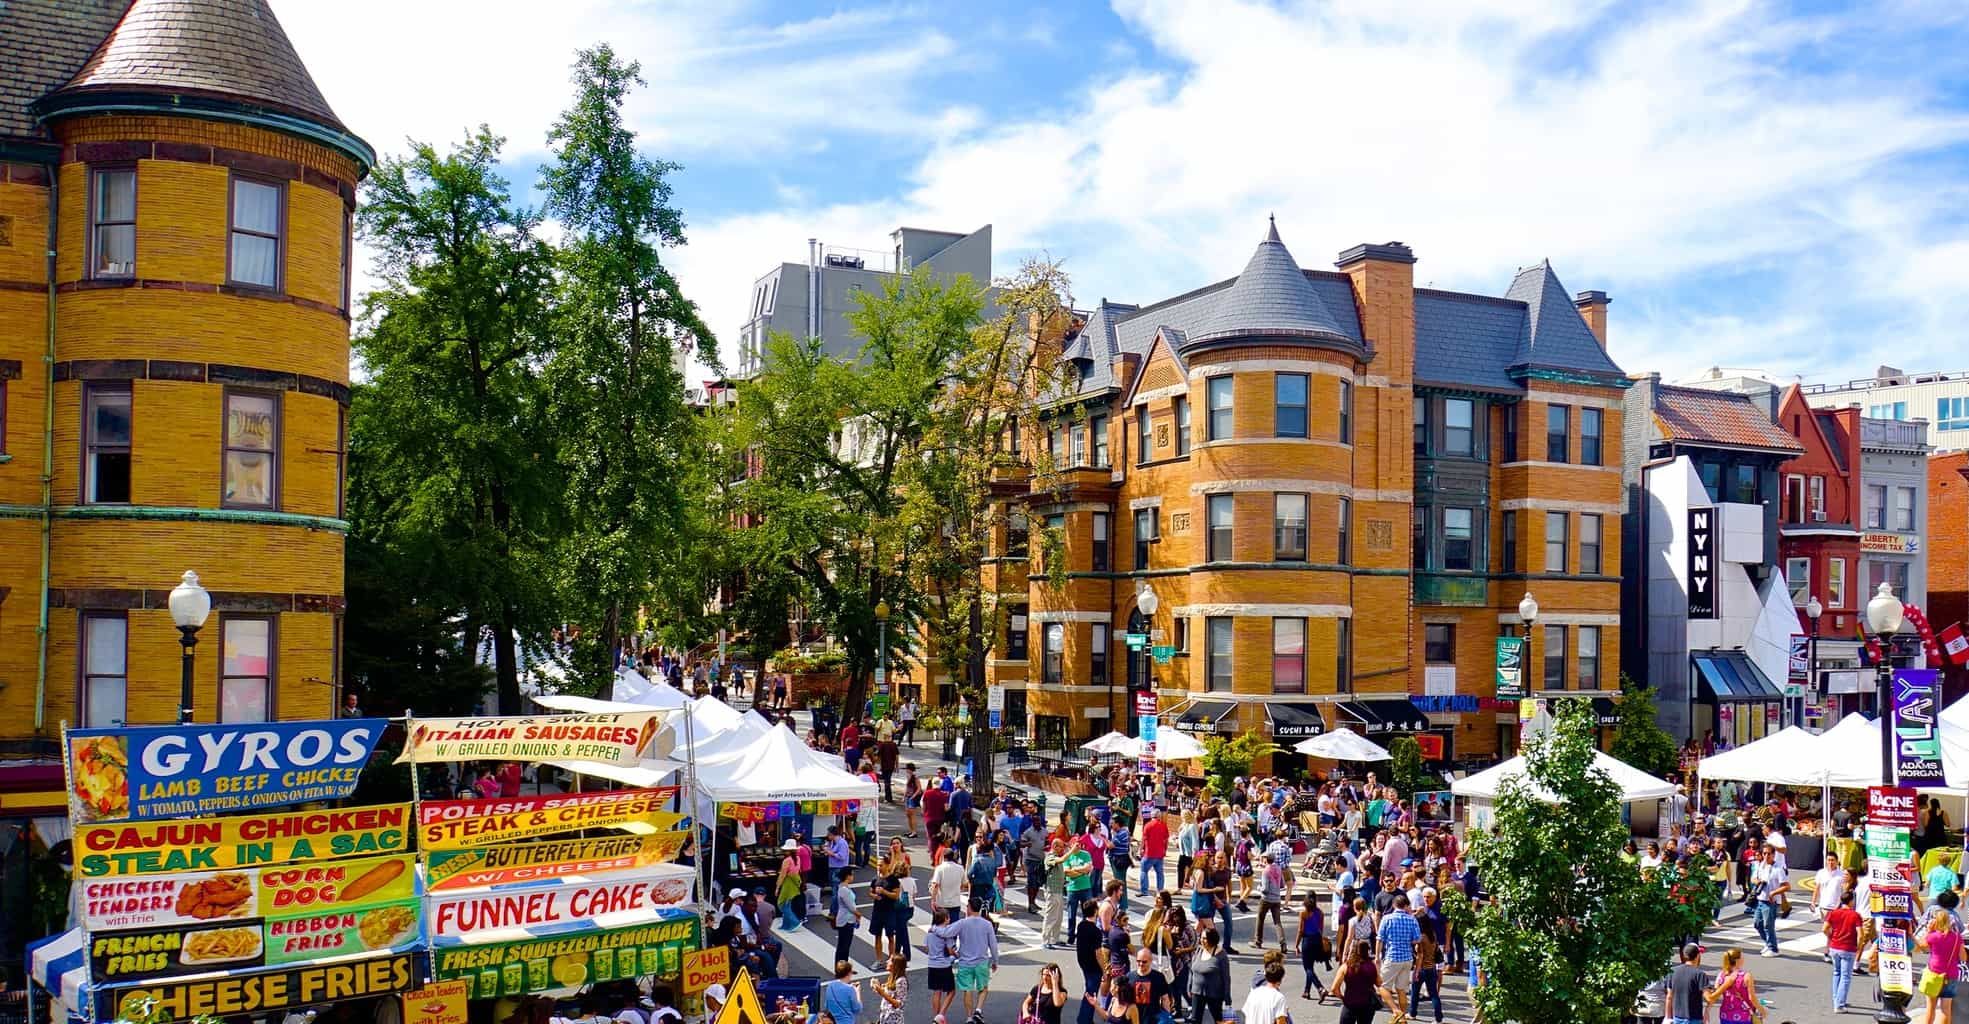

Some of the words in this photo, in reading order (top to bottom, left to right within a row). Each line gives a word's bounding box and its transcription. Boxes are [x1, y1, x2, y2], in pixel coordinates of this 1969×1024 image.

[1864, 534, 1899, 542] LIBERTY
[456, 719, 506, 729] HOT
[547, 714, 622, 724] SWEET
[1897, 678, 1936, 756] PLAY
[426, 727, 516, 742] ITALIAN
[523, 725, 639, 745] SAUSAGES
[1279, 726, 1302, 735] SUSHI
[1304, 726, 1320, 734] BAR
[142, 728, 370, 777] GYROS
[436, 743, 455, 757] W/
[458, 742, 507, 757] GRILLED
[512, 742, 557, 757] ONIONS
[562, 743, 570, 756] &
[576, 743, 621, 761] PEPPER
[1898, 769, 1943, 777] MORGAN
[1901, 761, 1938, 770] ADAMS
[138, 779, 201, 801] LAMB
[215, 773, 271, 794] BEEF
[137, 804, 151, 817] W/
[151, 800, 198, 815] TOMATO,
[199, 796, 241, 811] PEPPERS
[242, 795, 250, 806] &
[251, 791, 288, 805] ONIONS
[289, 790, 303, 801] ON
[304, 786, 324, 799] PITA
[423, 801, 535, 825] POLISH
[542, 790, 674, 810] SAUSAGE
[1870, 795, 1915, 808] RACINE
[85, 823, 222, 851] CAJUN
[239, 807, 403, 840] CHICKEN
[427, 814, 521, 843] STEAK
[530, 811, 547, 826] &
[559, 800, 665, 821] CHEESE
[475, 830, 522, 844] GRILLED
[525, 824, 573, 836] PEPPERS
[81, 846, 220, 877] STEAK
[236, 842, 274, 865] IN
[291, 838, 316, 859] A
[331, 829, 402, 855] SAC
[485, 839, 593, 868] BUTTERFLY
[593, 836, 642, 858] FRIES
[262, 866, 346, 888] CORN
[467, 871, 504, 884] W/
[514, 858, 632, 876] CHEESE
[87, 880, 176, 898] CHICKEN
[273, 884, 337, 908] DOG
[88, 895, 174, 917] TENDERS
[437, 892, 560, 935] FUNNEL
[569, 883, 649, 917] CAKE
[105, 916, 128, 926] with
[132, 913, 155, 923] Fries
[271, 913, 356, 936] RIBBON
[92, 932, 181, 958] FRENCH
[284, 932, 344, 953] FRIES
[442, 949, 505, 970] FRESH
[504, 934, 600, 964] SQUEEZED
[601, 920, 693, 949] LEMONADE
[105, 951, 169, 976] FRIES
[701, 951, 726, 968] Hot
[689, 970, 727, 986] Dogs
[118, 975, 288, 1023] CHEESE
[301, 957, 409, 1002] FRIES
[436, 1015, 460, 1024] Fries
